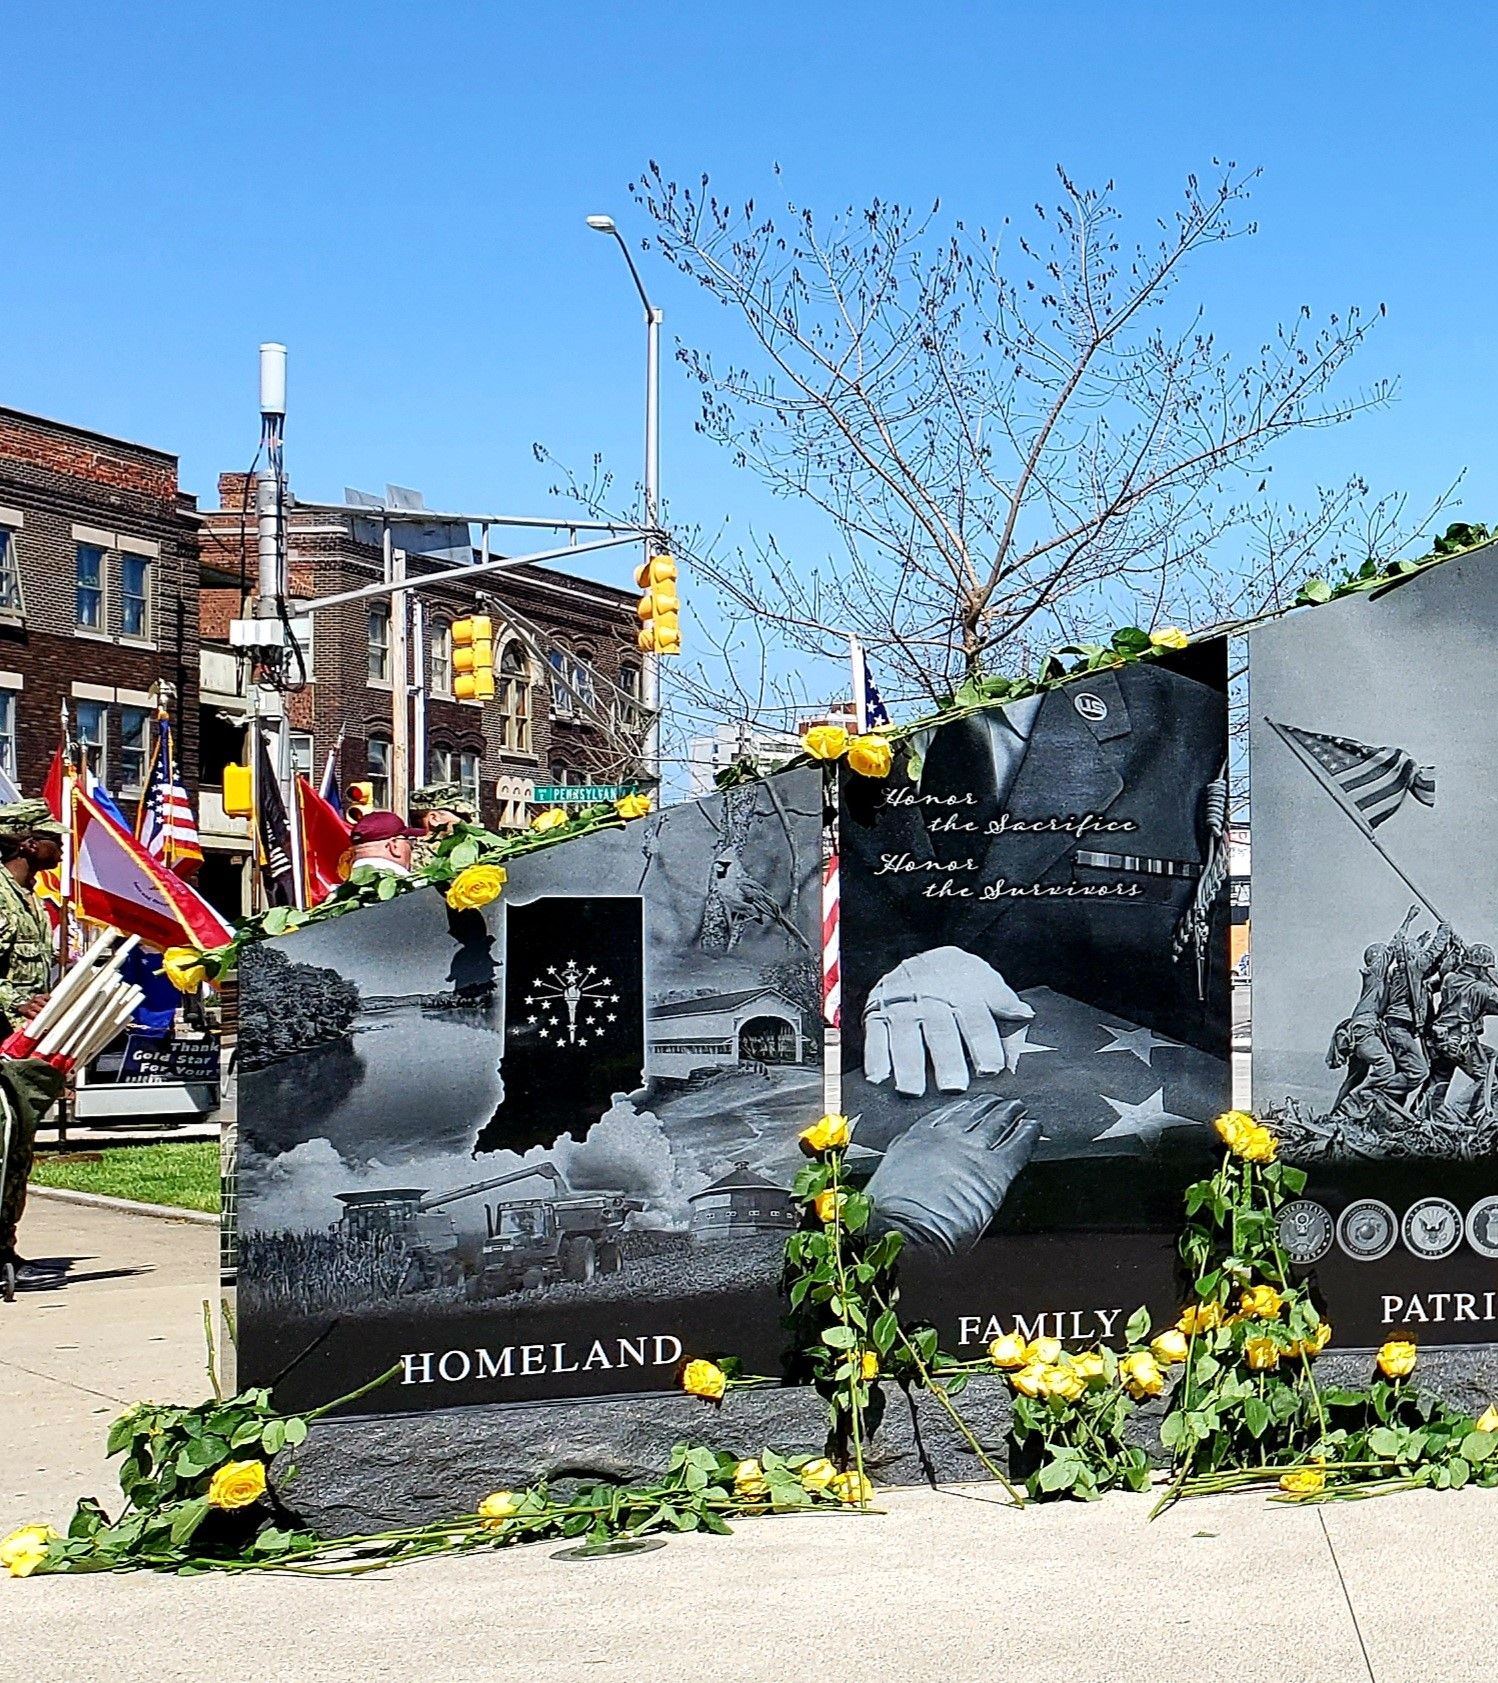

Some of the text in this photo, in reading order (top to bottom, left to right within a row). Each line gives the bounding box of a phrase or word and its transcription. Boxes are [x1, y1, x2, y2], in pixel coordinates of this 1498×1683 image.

[553, 788, 626, 801] PENNSYLVAN
[873, 786, 978, 808] Honor
[927, 813, 1137, 838] the Sacrifice
[873, 853, 979, 875] Honor
[922, 878, 1142, 900] the Survivors
[132, 1050, 212, 1065] Gold Star
[170, 1042, 219, 1052] Thank
[140, 1062, 213, 1076] For Your
[958, 1308, 1123, 1346] FAMILY
[400, 1334, 683, 1385] HOMELAND
